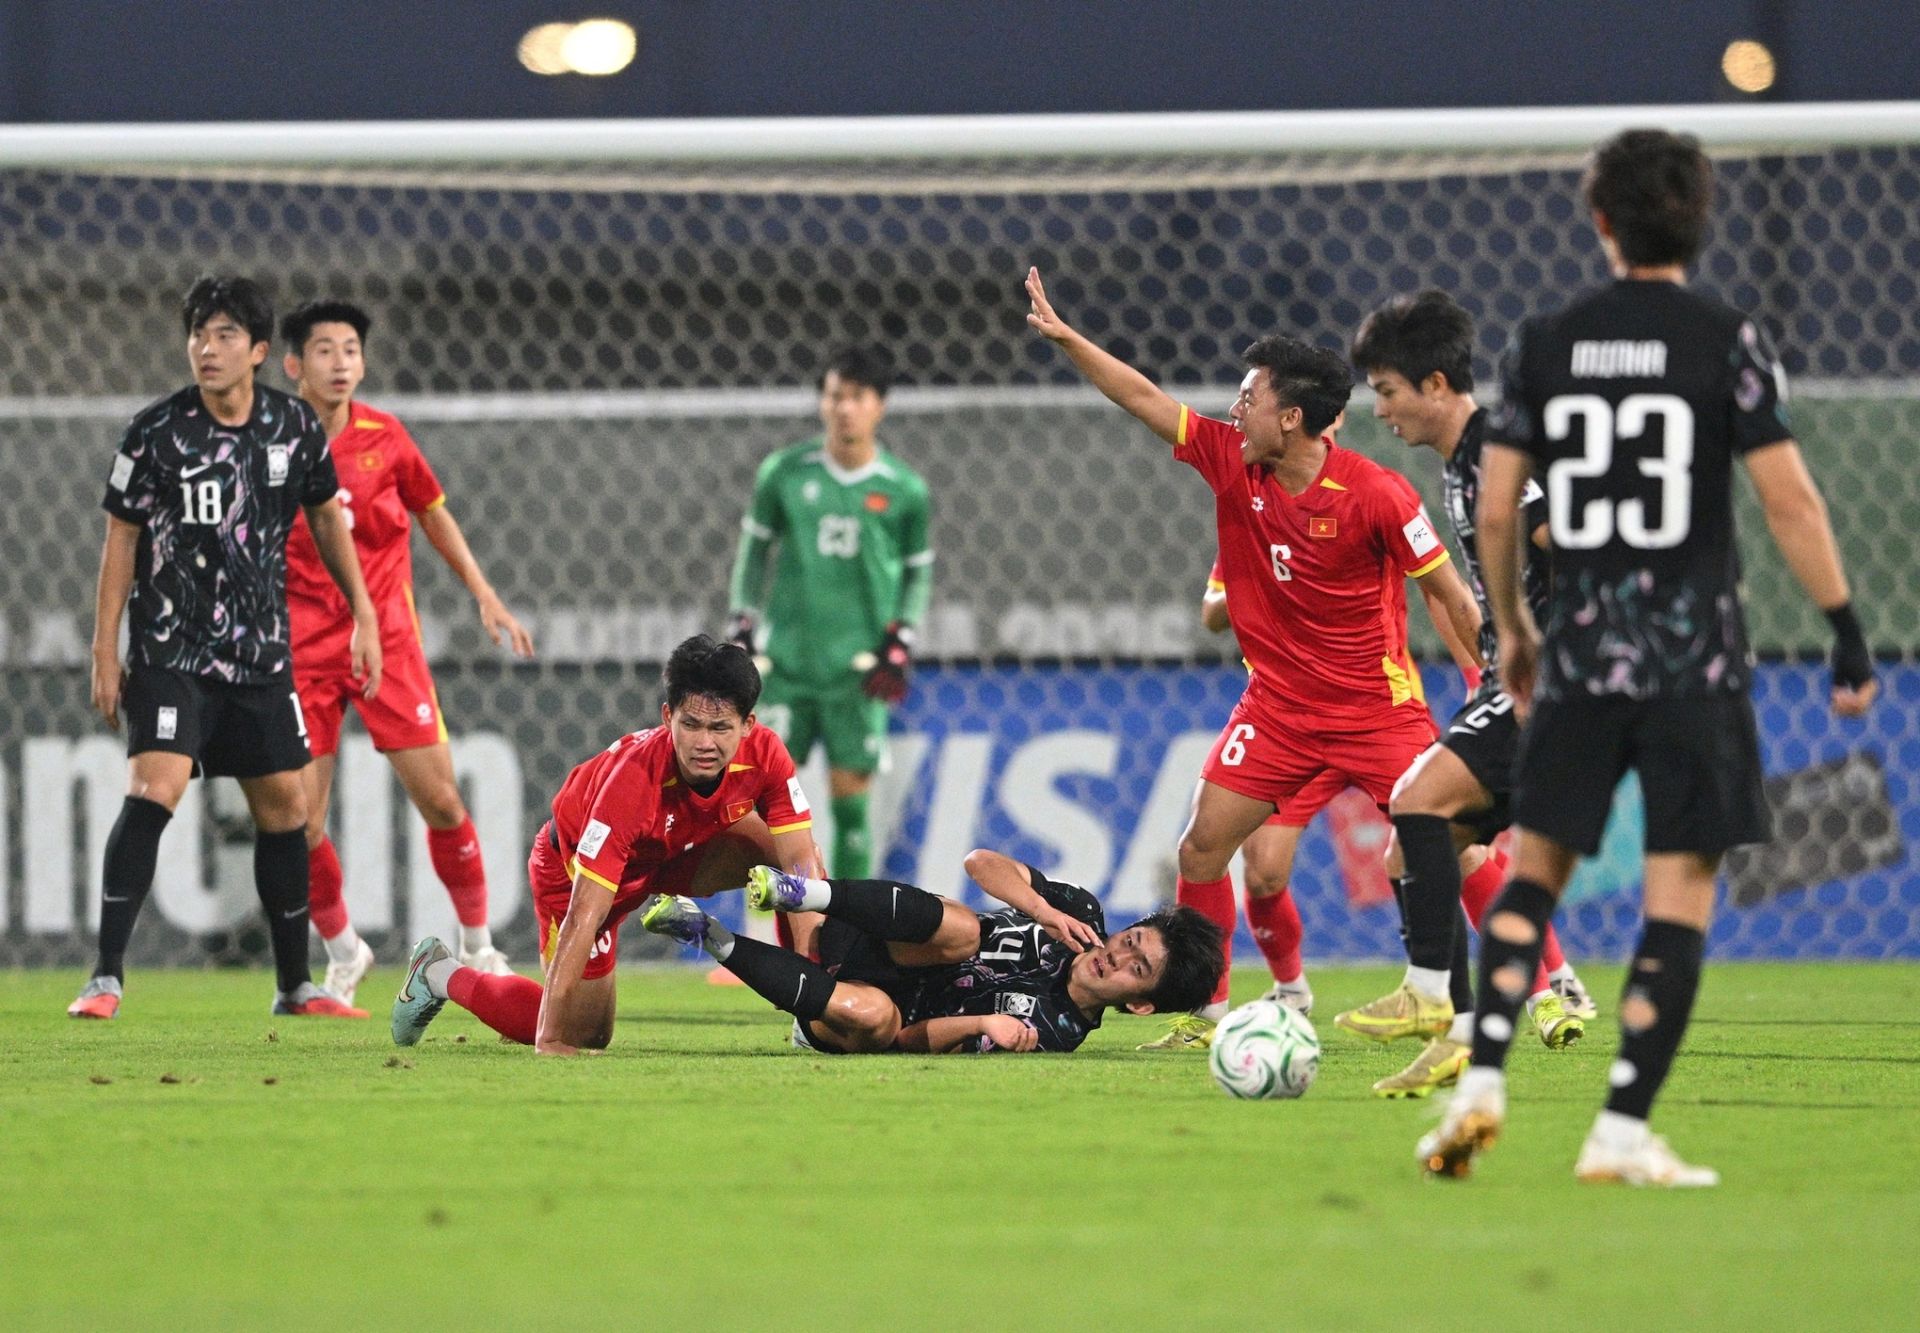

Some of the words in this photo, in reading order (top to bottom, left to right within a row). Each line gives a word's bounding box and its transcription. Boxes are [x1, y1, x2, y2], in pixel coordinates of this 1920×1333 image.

[1544, 393, 1695, 549] 23
[180, 480, 223, 525] 18
[1270, 543, 1293, 581] 6
[1219, 723, 1256, 766] 6
[795, 730, 1250, 915] VISA
[979, 922, 1035, 961] 14
